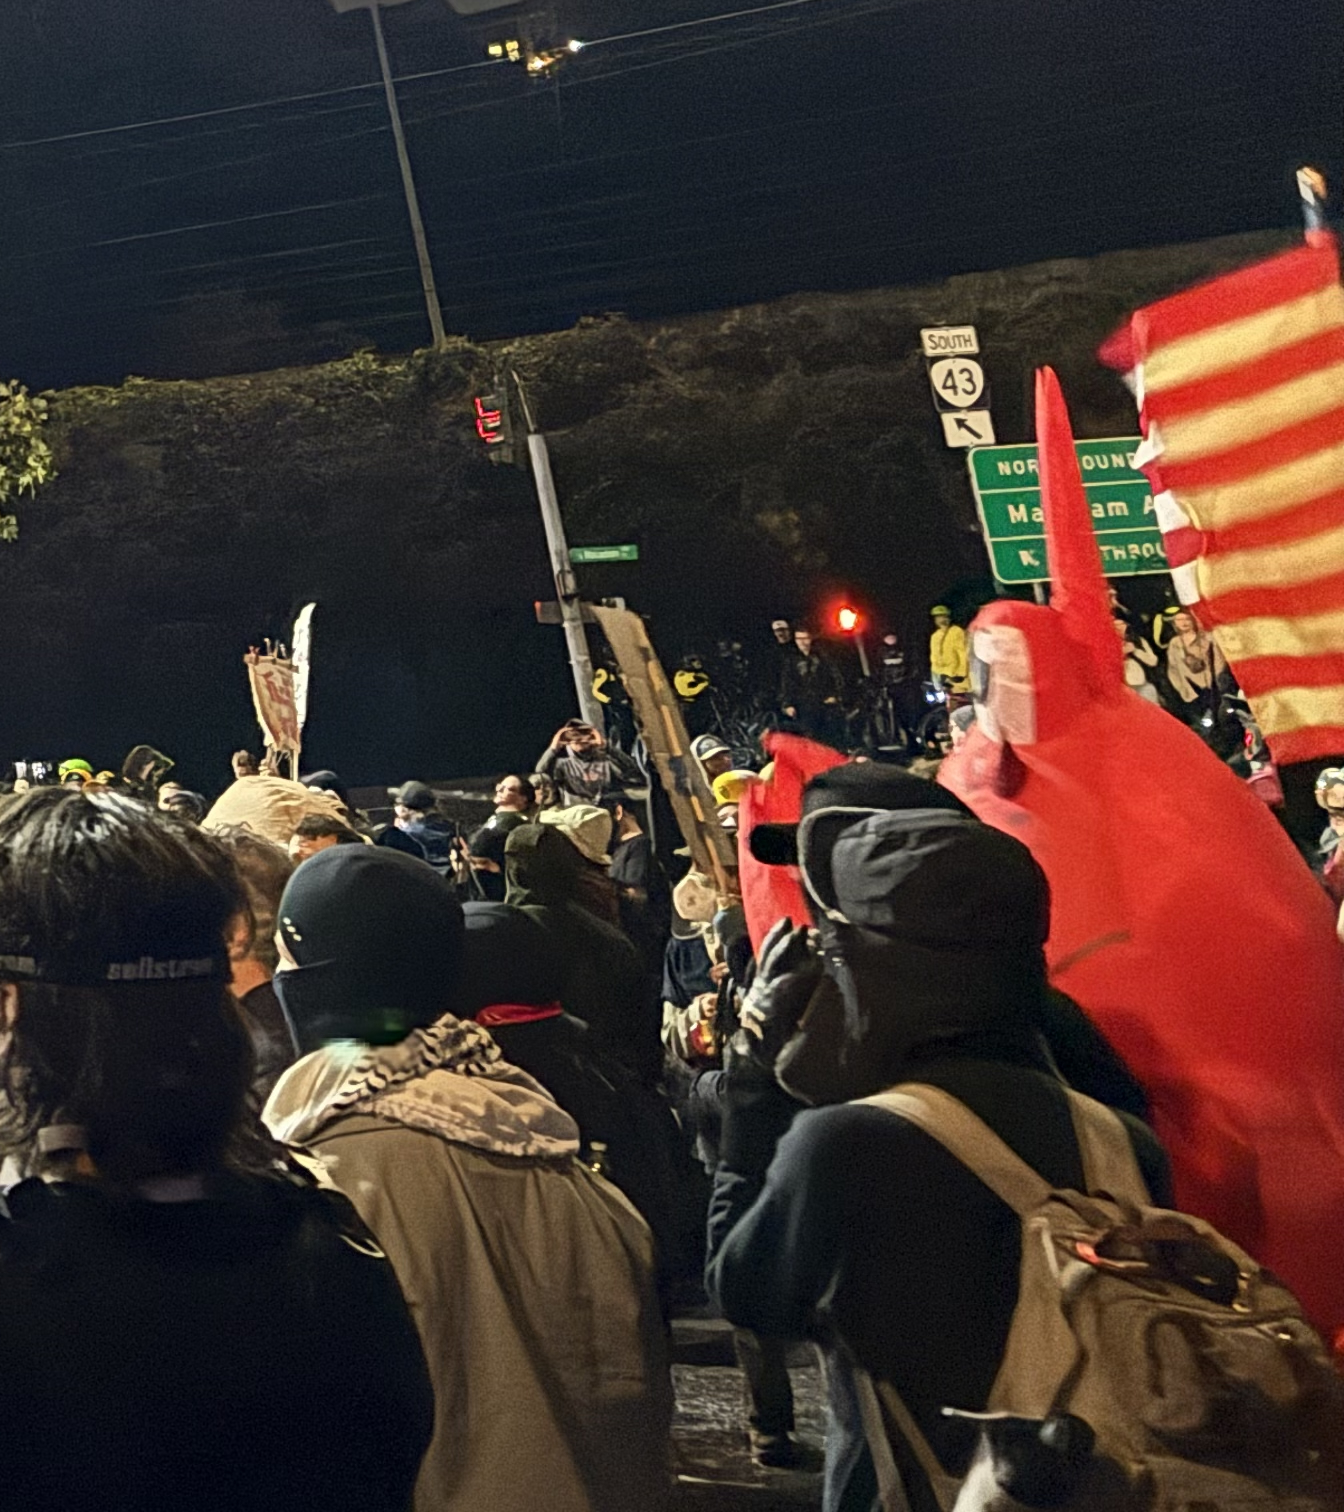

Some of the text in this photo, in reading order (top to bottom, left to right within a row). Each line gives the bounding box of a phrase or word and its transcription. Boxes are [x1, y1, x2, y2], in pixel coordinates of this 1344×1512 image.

[928, 334, 973, 351] SOUTH
[942, 367, 977, 396] 43
[997, 453, 1137, 476] NOROUND
[1007, 500, 1129, 524] Maam
